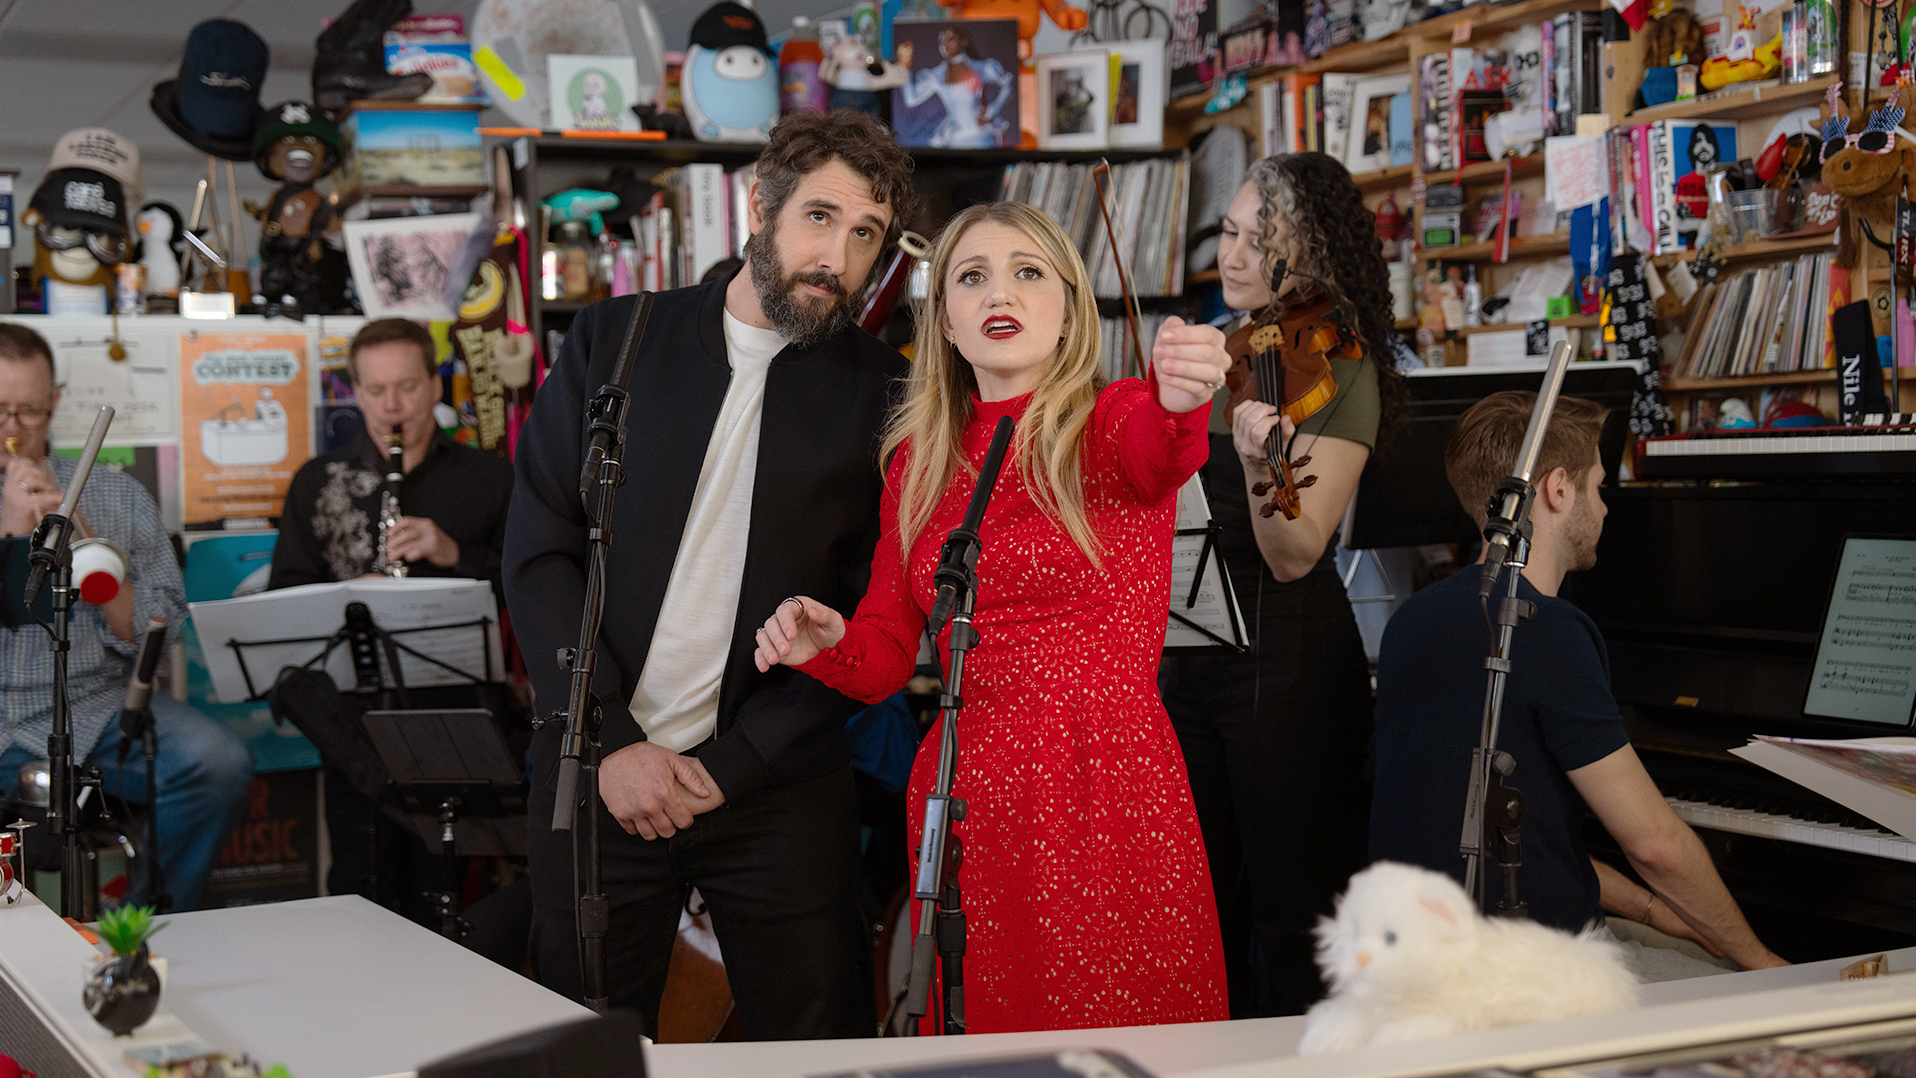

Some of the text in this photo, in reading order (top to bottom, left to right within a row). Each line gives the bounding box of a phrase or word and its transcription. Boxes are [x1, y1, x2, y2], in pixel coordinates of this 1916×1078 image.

[1464, 65, 1512, 87] ASK
[1657, 121, 1668, 167] THIS
[1659, 209, 1671, 248] CALL
[196, 363, 292, 379] CONTEST
[1842, 353, 1861, 407] Nile
